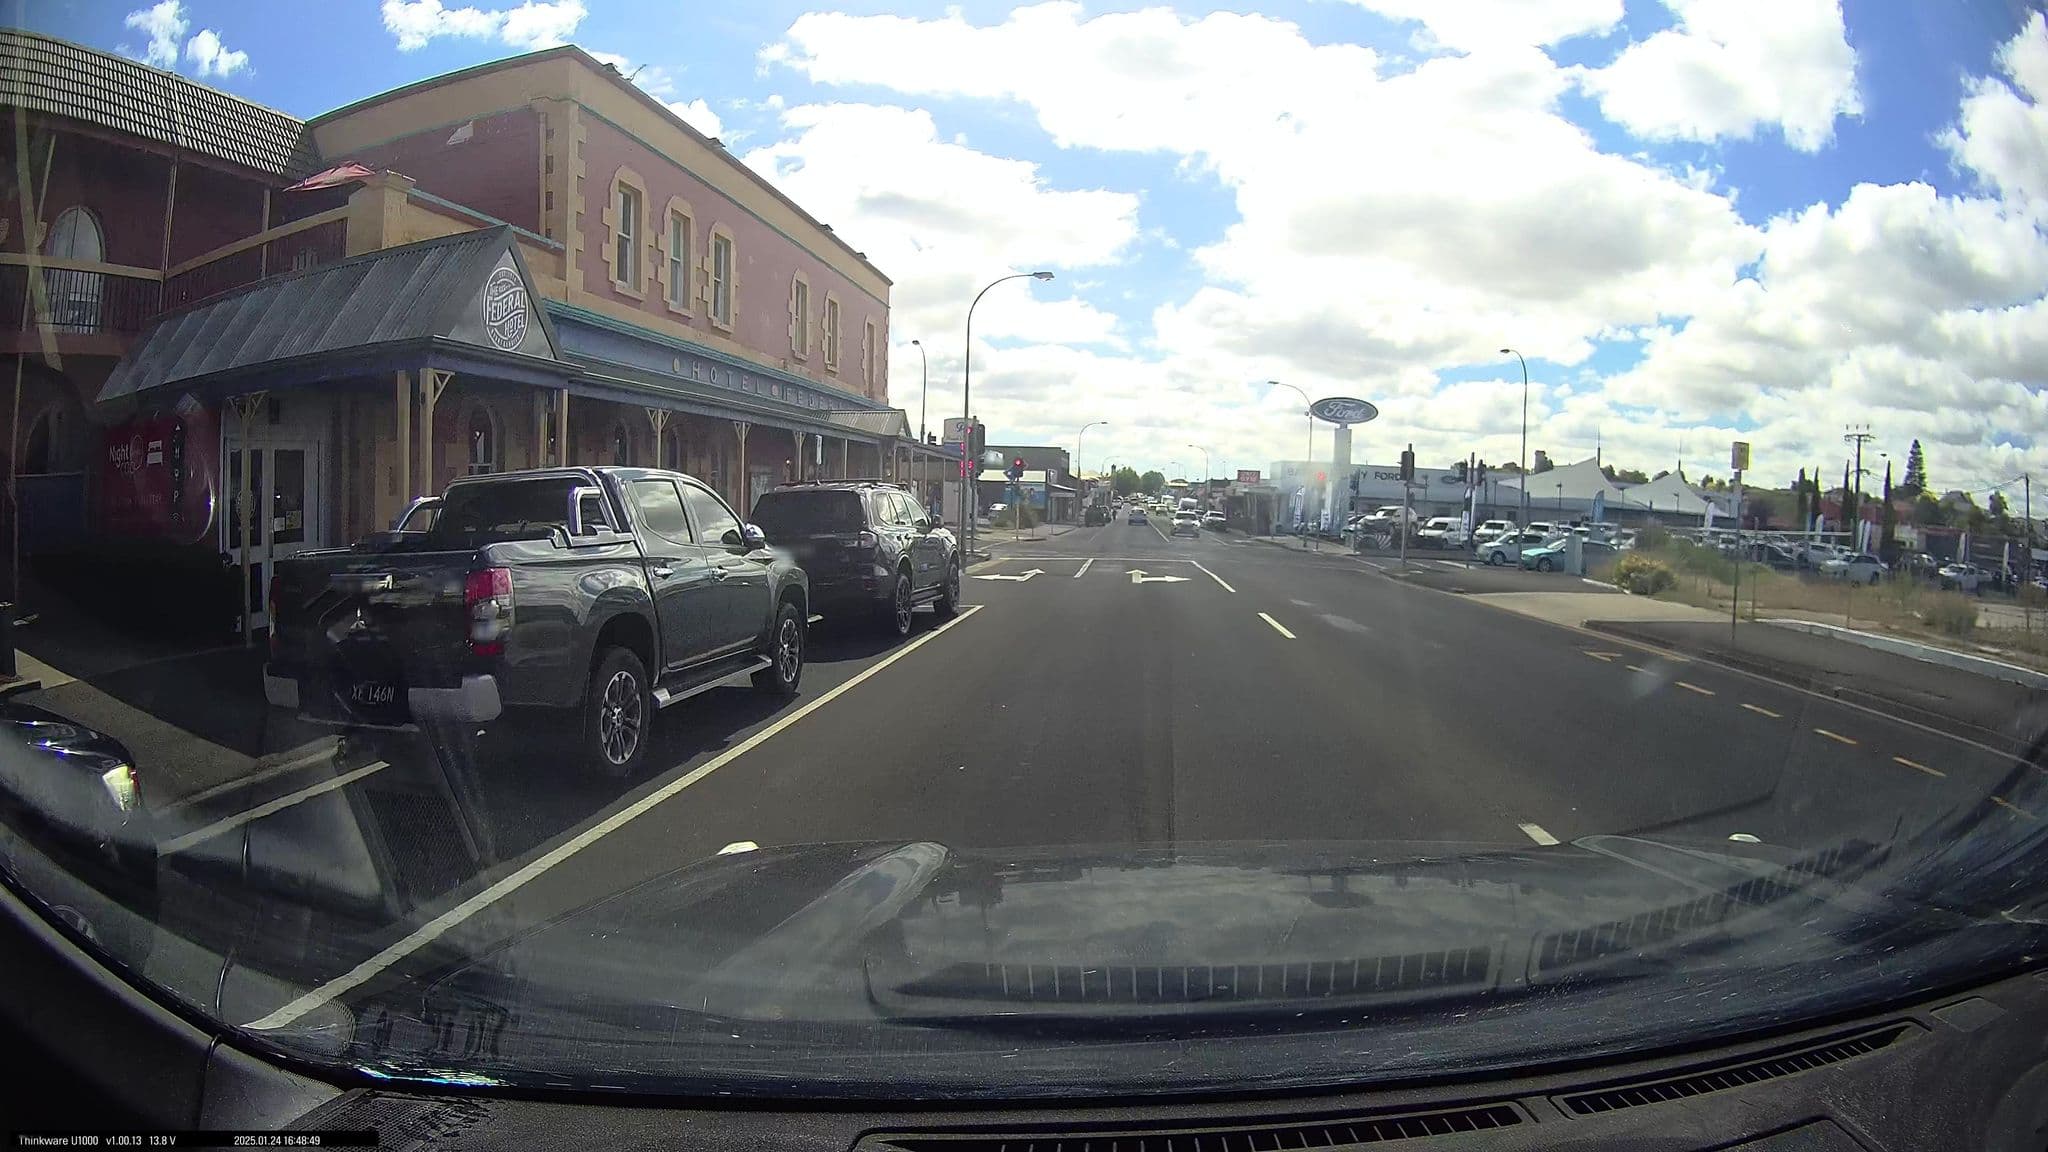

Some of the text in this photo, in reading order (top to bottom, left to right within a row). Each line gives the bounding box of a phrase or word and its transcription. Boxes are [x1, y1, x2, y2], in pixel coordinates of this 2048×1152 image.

[486, 291, 525, 325] FEDERAL
[504, 314, 524, 337] HOTEL
[690, 361, 764, 395] HOTEL
[1324, 401, 1366, 419] Ford
[368, 685, 395, 703] 146N
